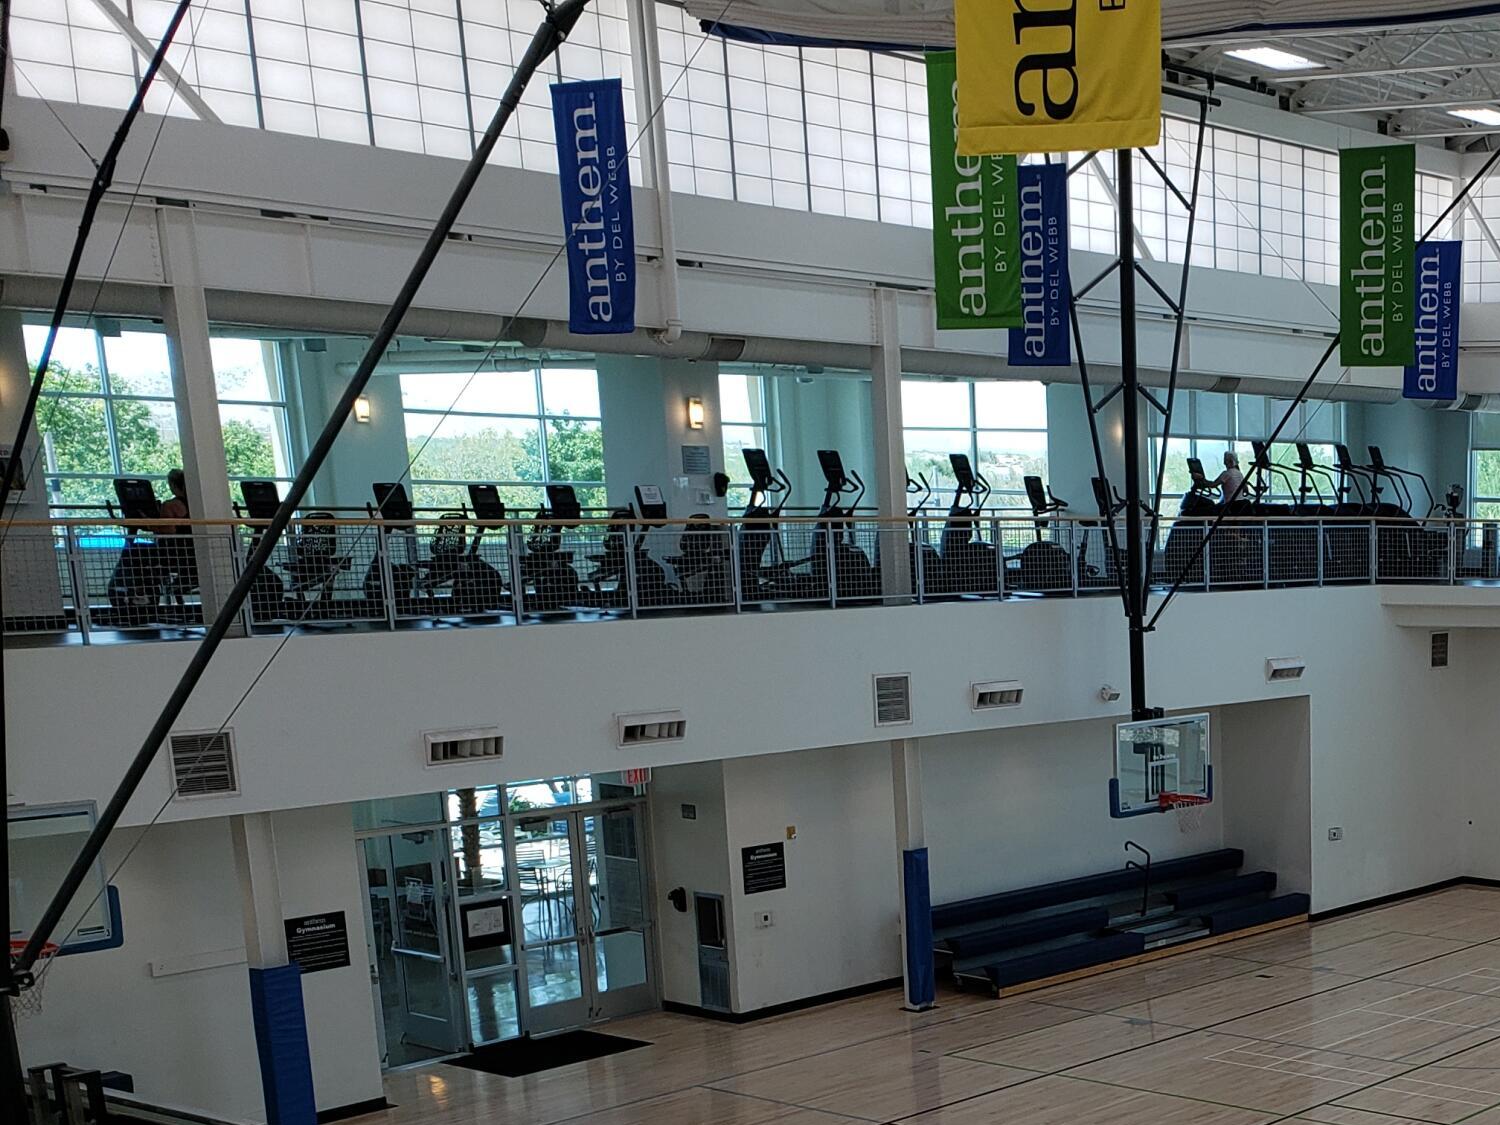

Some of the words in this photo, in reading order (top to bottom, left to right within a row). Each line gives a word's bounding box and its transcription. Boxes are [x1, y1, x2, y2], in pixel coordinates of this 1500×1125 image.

[606, 145, 619, 205] WEBB
[945, 80, 987, 317] anthe
[993, 194, 1005, 239] DEL
[610, 210, 624, 250] DEL
[1048, 216, 1058, 263] WEBB
[1392, 201, 1404, 254] WEBB
[615, 258, 627, 282] BY
[994, 248, 1007, 272] BY
[1392, 259, 1404, 296] DEL
[1050, 269, 1060, 299] DEL
[1443, 281, 1452, 319] WEBB
[1050, 306, 1060, 326] BY
[1392, 301, 1404, 322] BY
[1442, 322, 1451, 348] DEL
[1441, 352, 1450, 368] BY
